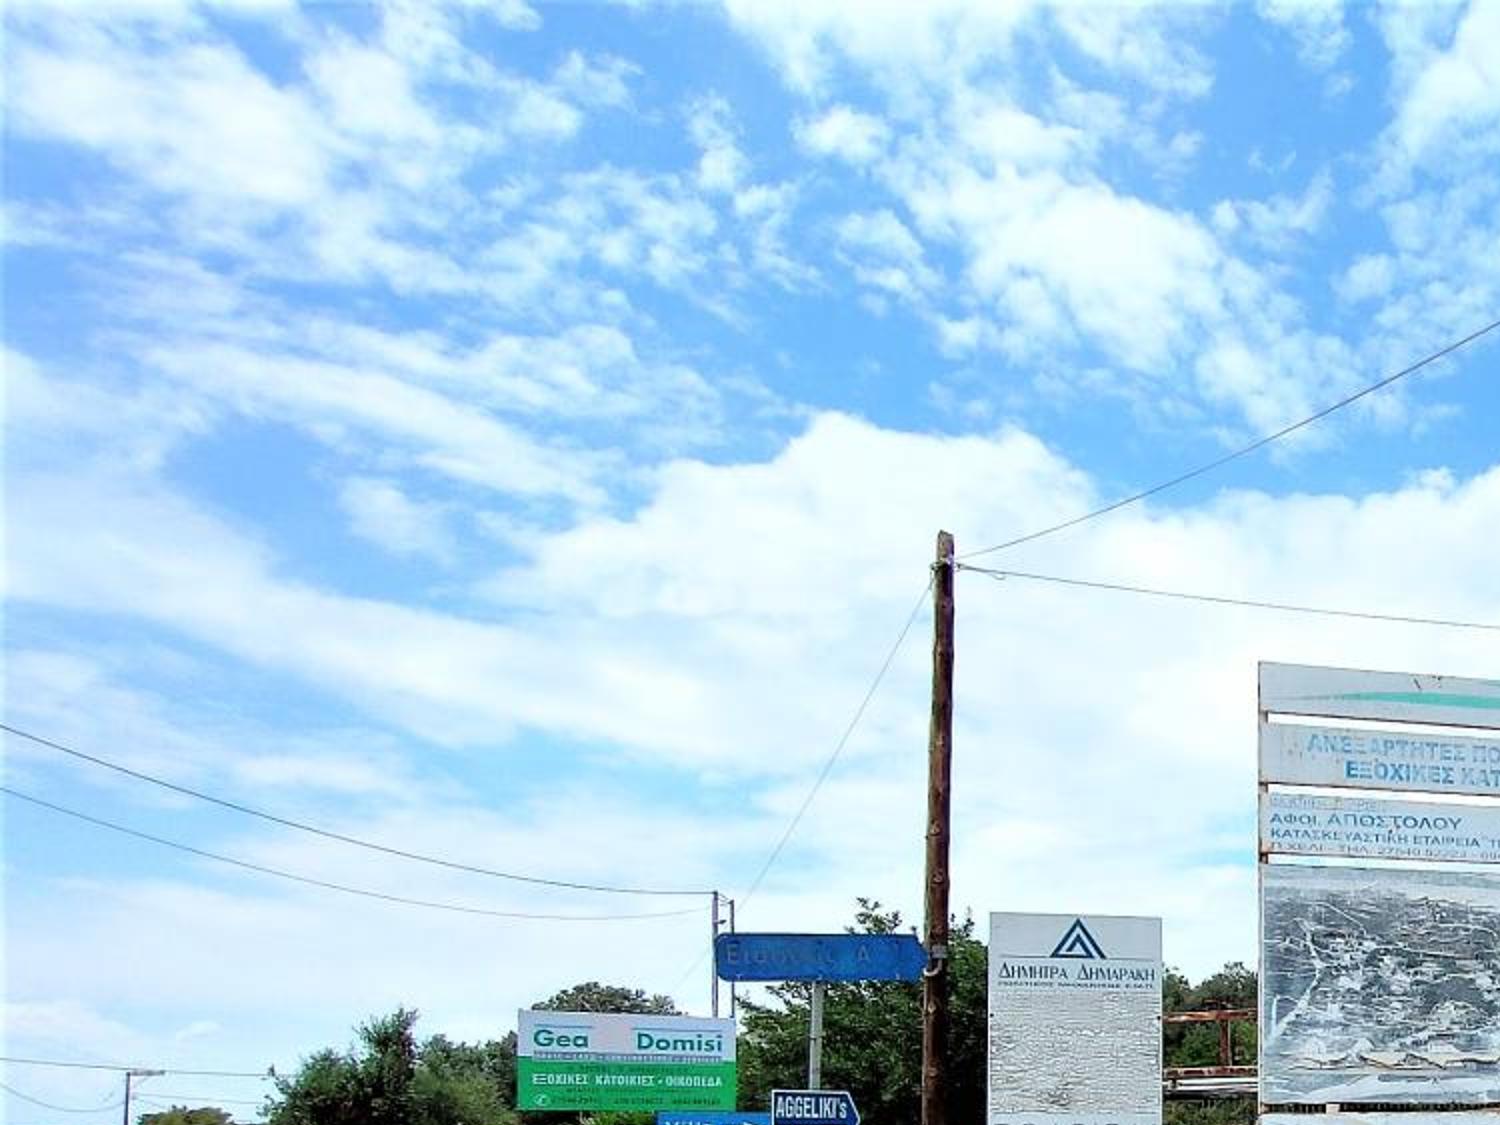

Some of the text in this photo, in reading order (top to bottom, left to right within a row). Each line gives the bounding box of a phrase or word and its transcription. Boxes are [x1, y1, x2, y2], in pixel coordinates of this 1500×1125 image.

[1327, 813, 1462, 831] ΑΠΟΣΤΟΛΟΥ
[999, 962, 1155, 981] ΔΗΜΗΤΡΑ ΔΗΜΑΡΑΚΗ
[533, 1029, 723, 1052] Gea Domisi
[533, 1073, 588, 1085] ΕΞΟΧΙΚΕΣ
[595, 1074, 655, 1087] ΚΑΤΟΙΚΙΕΣ
[775, 1096, 848, 1119] AGGELIKI's
